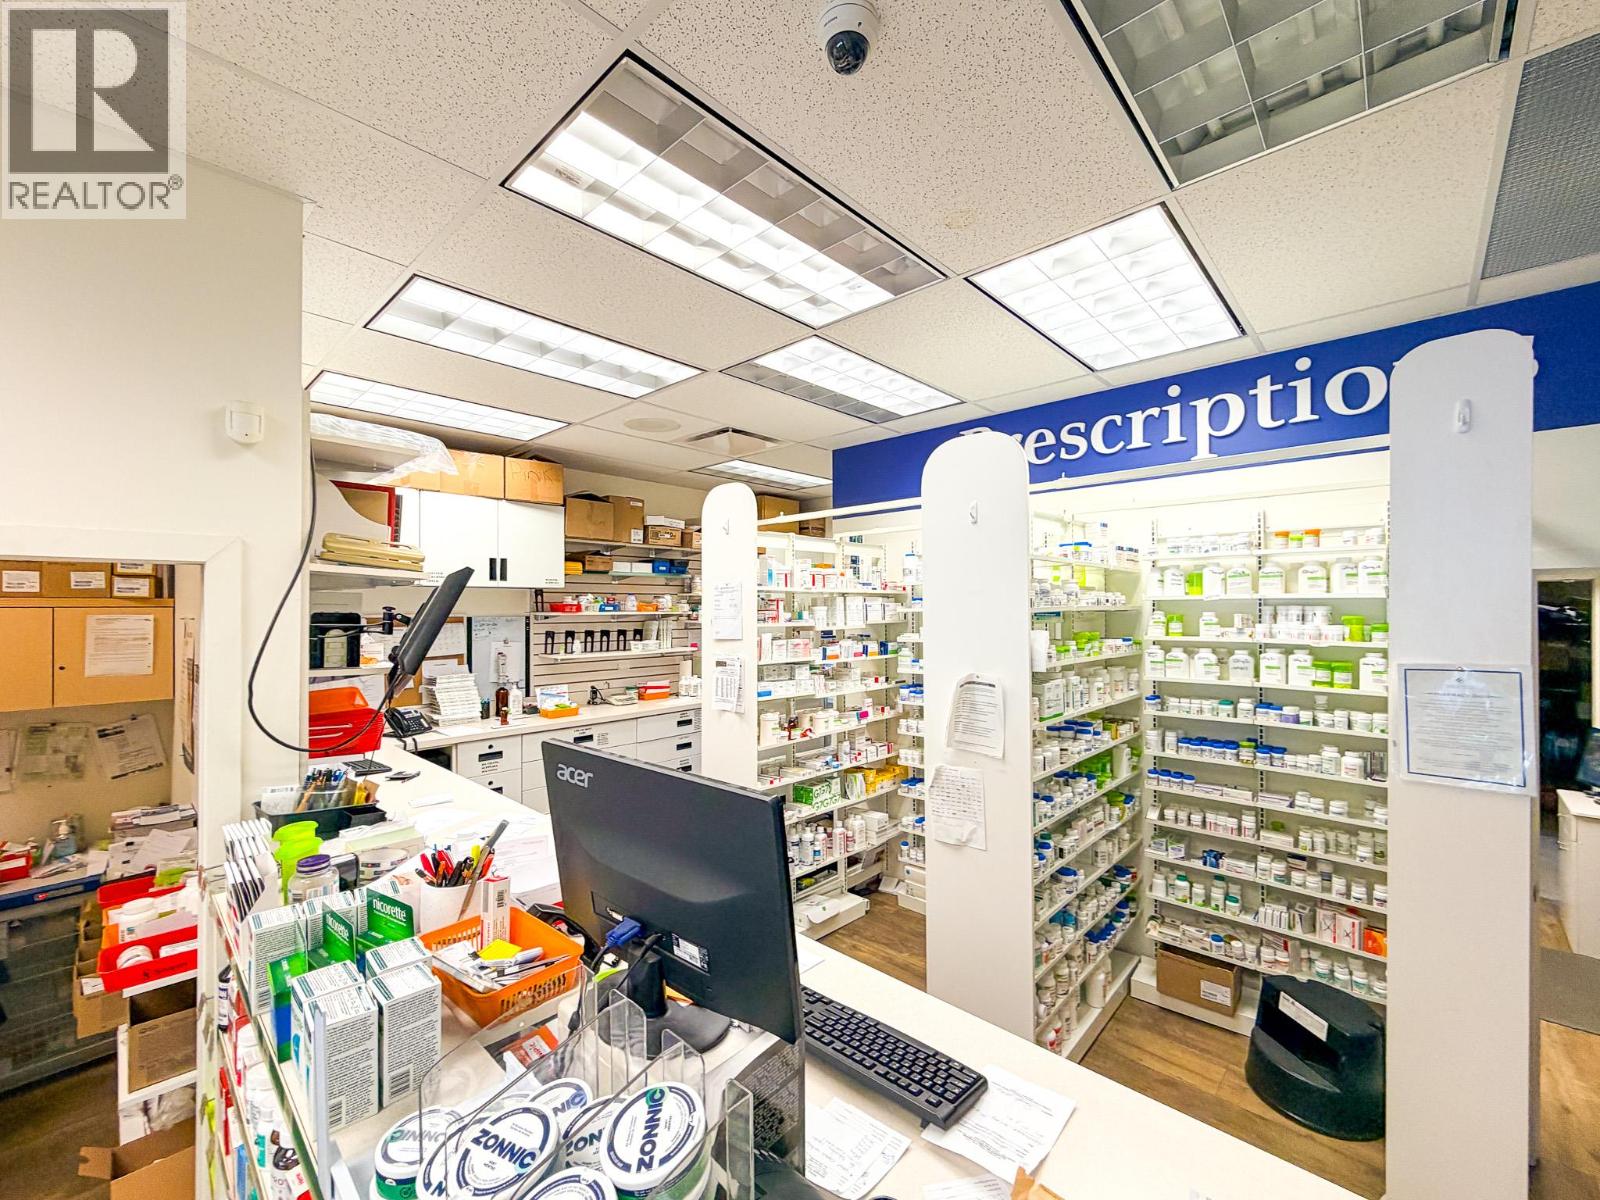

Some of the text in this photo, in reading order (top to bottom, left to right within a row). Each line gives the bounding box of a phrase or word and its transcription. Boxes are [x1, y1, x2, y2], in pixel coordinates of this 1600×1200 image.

[959, 335, 1539, 462] escriptio
[556, 763, 594, 788] acer
[372, 897, 407, 921] nicorette
[325, 913, 350, 941] nicorette
[565, 1127, 606, 1157] ZON
[636, 1087, 667, 1173] ZONNIC
[470, 1127, 537, 1169] ZONNIC
